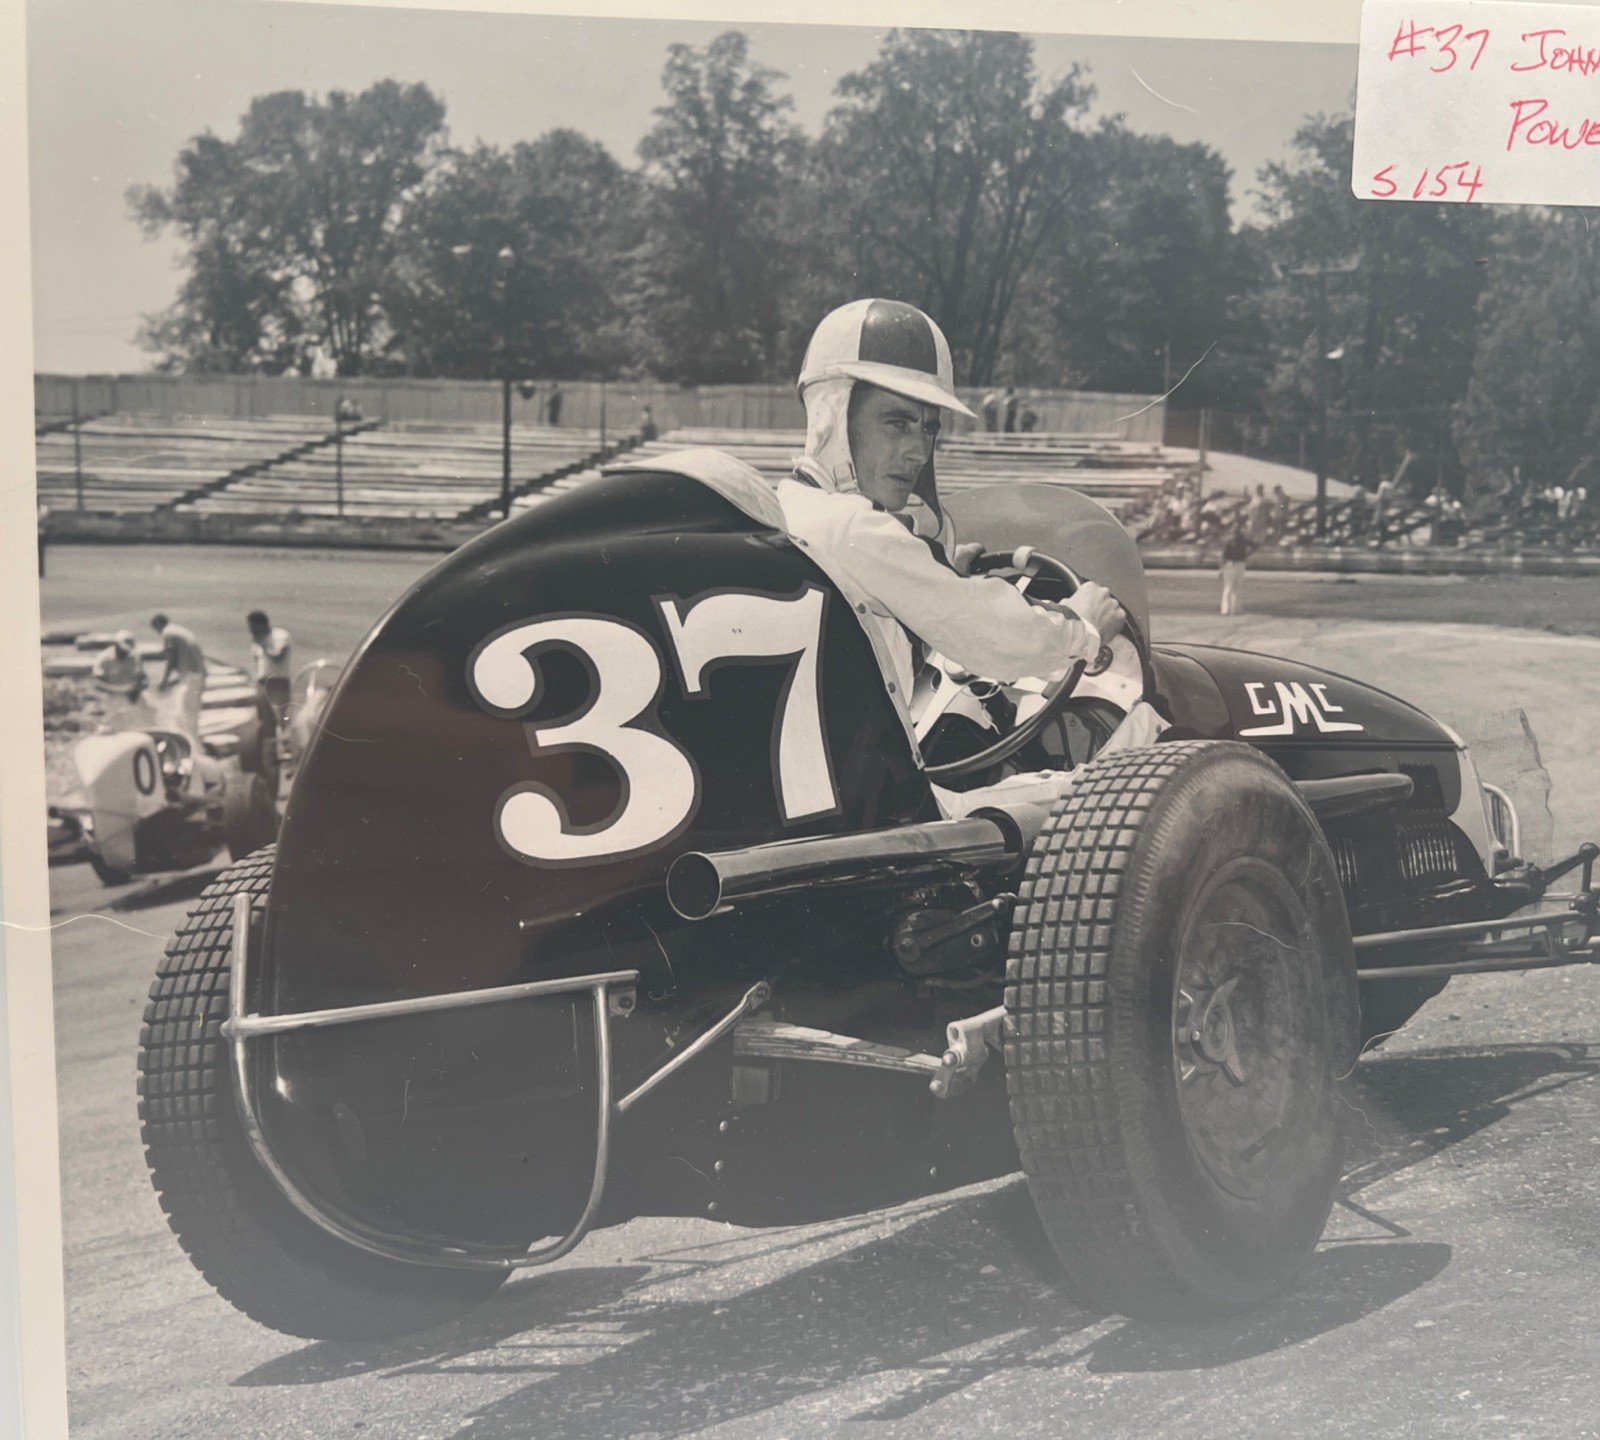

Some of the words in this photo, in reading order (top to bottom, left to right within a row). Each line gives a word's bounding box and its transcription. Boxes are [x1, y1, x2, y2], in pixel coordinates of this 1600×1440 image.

[1387, 20, 1490, 73] #37
[472, 586, 838, 860] 37
[1238, 681, 1364, 737] GMC
[133, 746, 157, 795] 0
